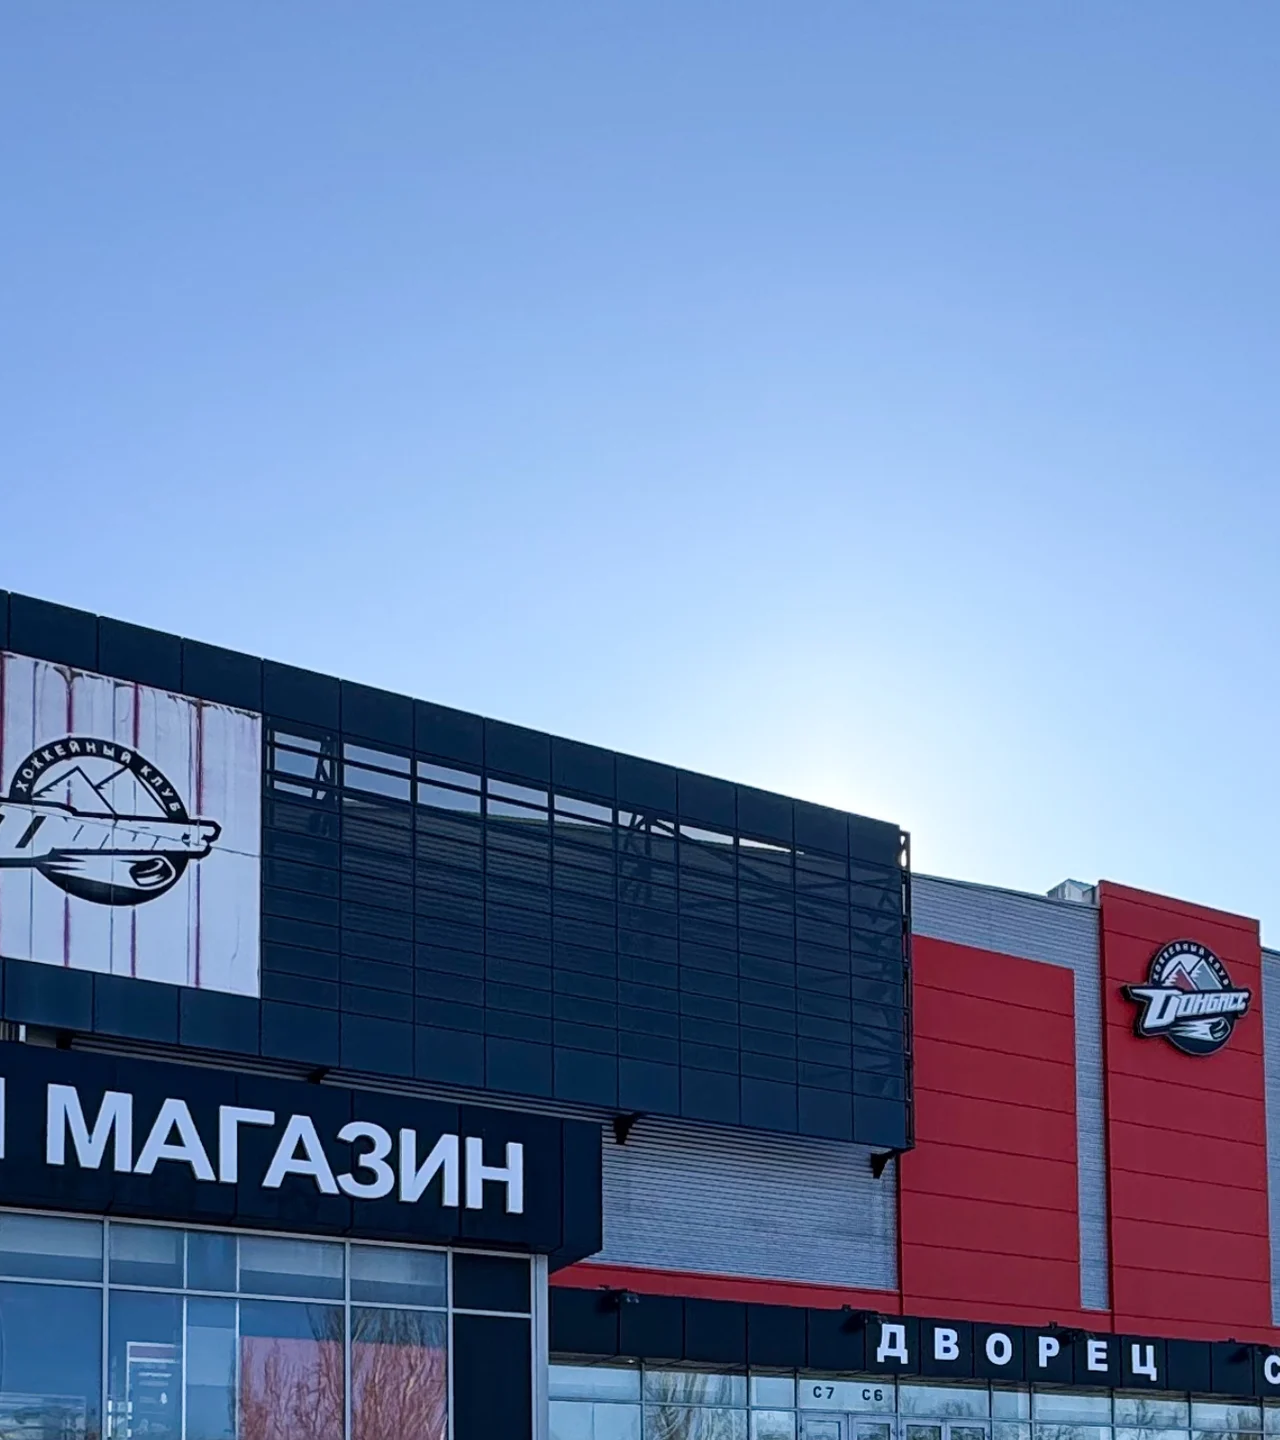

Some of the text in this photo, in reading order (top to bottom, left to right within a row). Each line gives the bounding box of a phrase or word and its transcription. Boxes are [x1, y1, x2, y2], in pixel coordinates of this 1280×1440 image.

[16, 740, 181, 812] ХОККЕЙНЫЙ КЛУБ
[47, 1083, 523, 1214] МАГАЗИН
[876, 1323, 1158, 1382] ДВОРЕЦ
